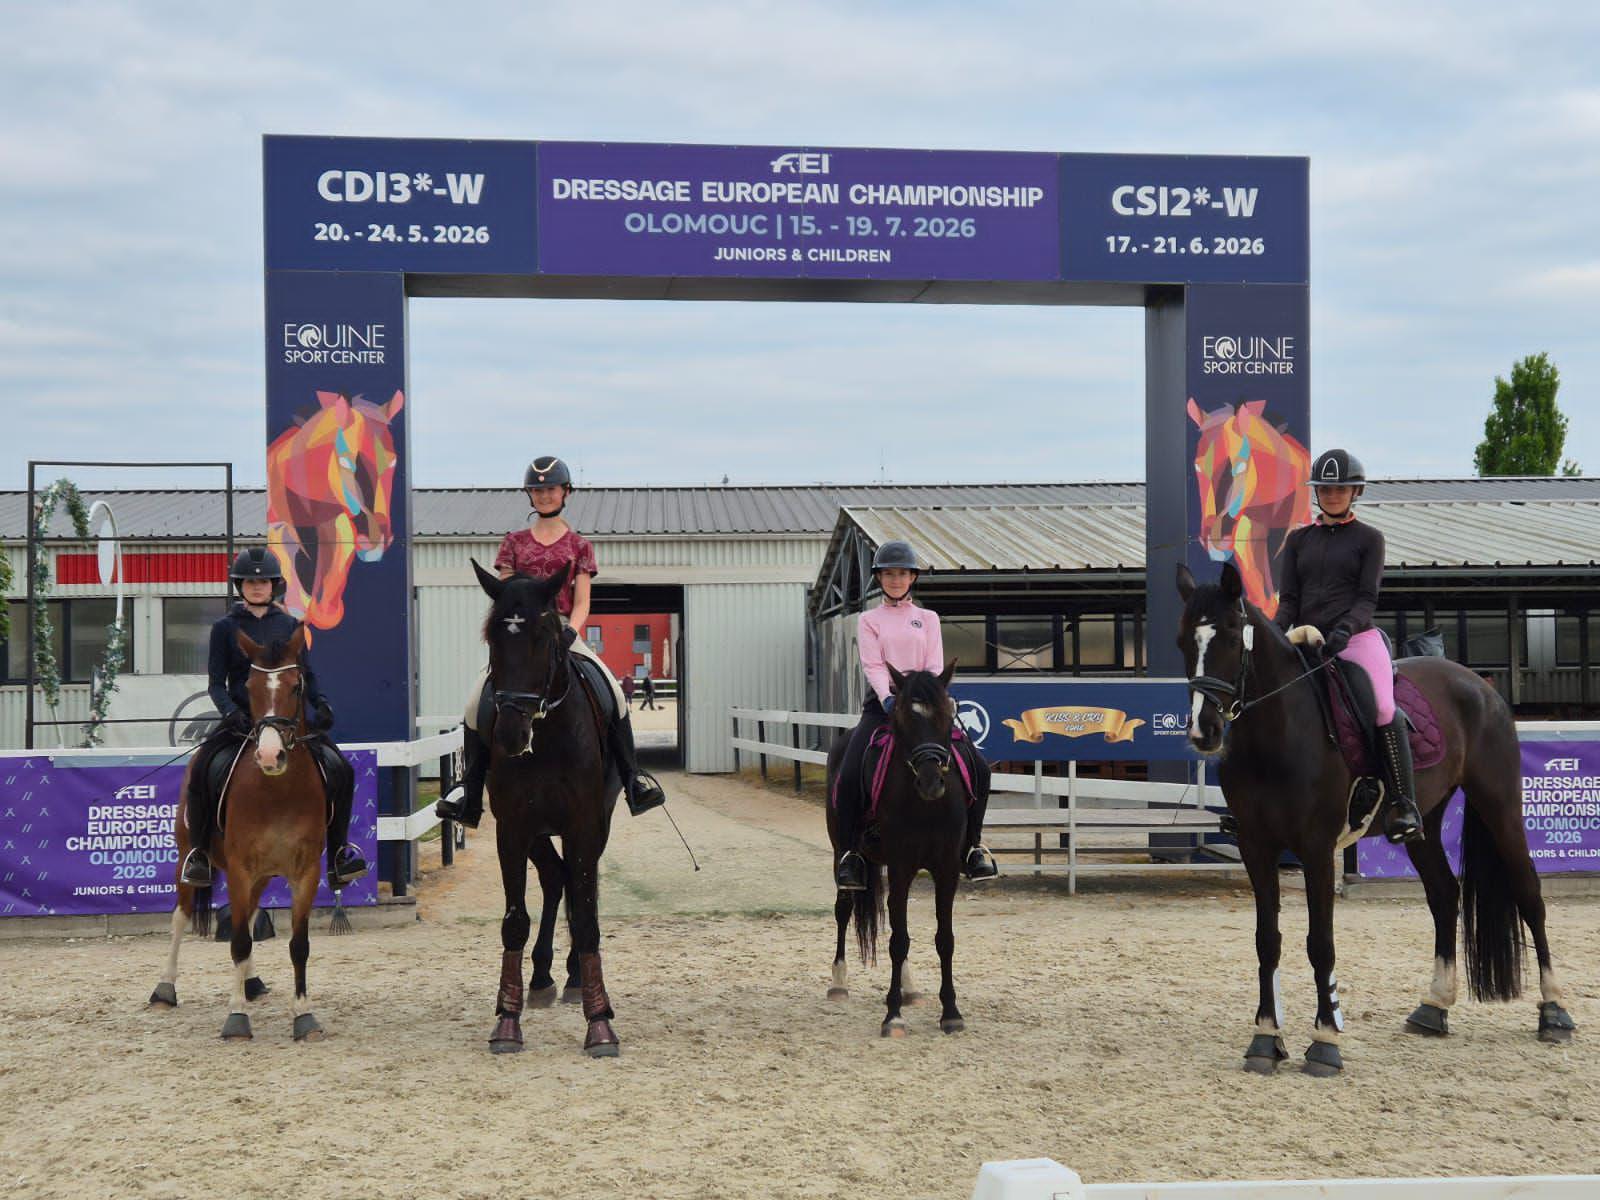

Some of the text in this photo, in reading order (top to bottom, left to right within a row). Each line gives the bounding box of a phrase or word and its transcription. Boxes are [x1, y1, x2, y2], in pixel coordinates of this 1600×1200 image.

[770, 152, 832, 174] FEI
[552, 178, 1044, 208] DRESSAGE EUROPEAN CHAMPIONSHIP
[314, 222, 350, 242] 20.
[367, 223, 403, 243] 24.
[408, 224, 429, 243] 5.
[433, 225, 490, 244] 2026
[624, 212, 769, 236] OLOMOUC
[789, 215, 823, 236] 15.
[845, 215, 879, 237] 19.
[885, 216, 907, 238] 7.
[913, 217, 977, 239] 2026
[1106, 235, 1138, 253] 17.
[1153, 236, 1186, 254] 21.
[1190, 237, 1210, 255] 6.
[1213, 237, 1265, 255] 2026
[713, 247, 892, 263] JUNIORS & CHILDREN
[284, 323, 385, 349] EQUINE
[1203, 336, 1295, 360] EQUINE
[284, 350, 385, 364] SPORT CENTER
[1203, 361, 1294, 375] SPORT CENTER
[1153, 713, 1189, 729] EQU
[1544, 758, 1581, 771] FEI
[1522, 776, 1600, 789] DRESSAGE
[113, 785, 157, 799] FEI
[1521, 789, 1600, 803] EUROPEAN
[1522, 803, 1600, 818] AMPIONS
[1525, 817, 1600, 830] OLOMOUC
[65, 834, 177, 851] CHAMPIONS
[1545, 831, 1582, 844] 2026
[89, 849, 180, 865] OLOMOUC
[1567, 848, 1600, 858] CHILD
[112, 864, 157, 880] 2026
[73, 884, 177, 896] JUNIORS & CHILD
